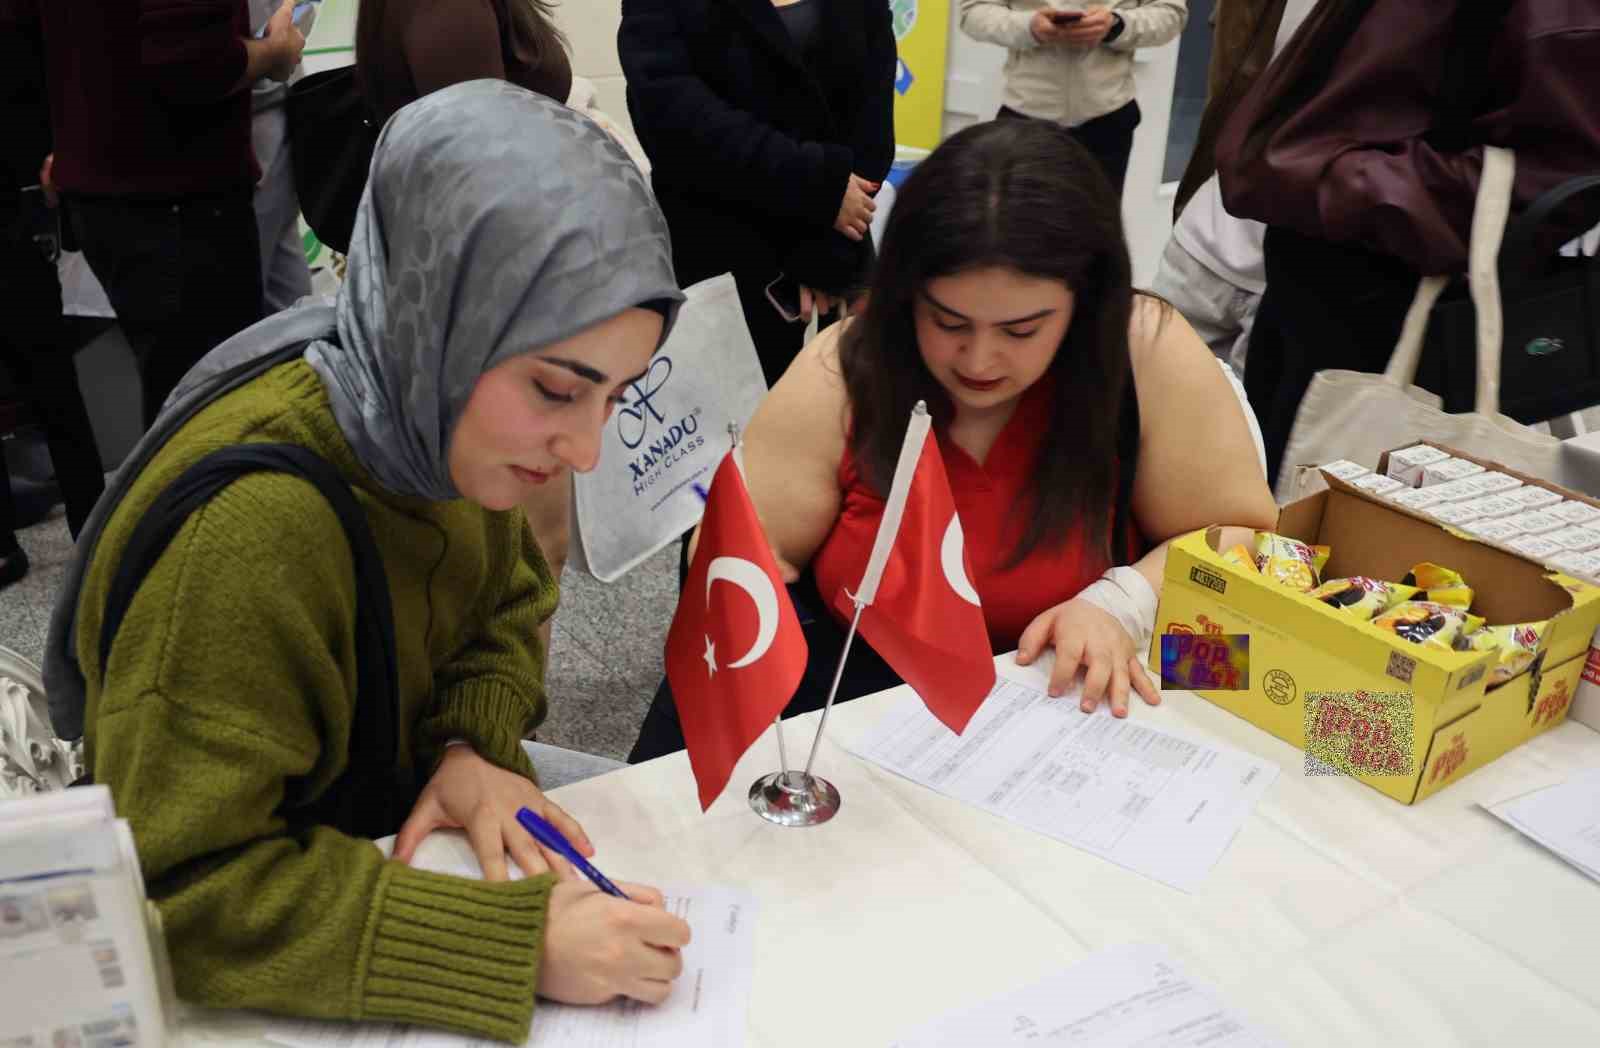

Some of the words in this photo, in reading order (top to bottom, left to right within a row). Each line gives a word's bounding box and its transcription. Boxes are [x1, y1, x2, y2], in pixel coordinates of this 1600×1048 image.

[627, 415, 698, 482] XANADU
[633, 468, 663, 497] HIGH
[664, 435, 705, 469] CLASS
